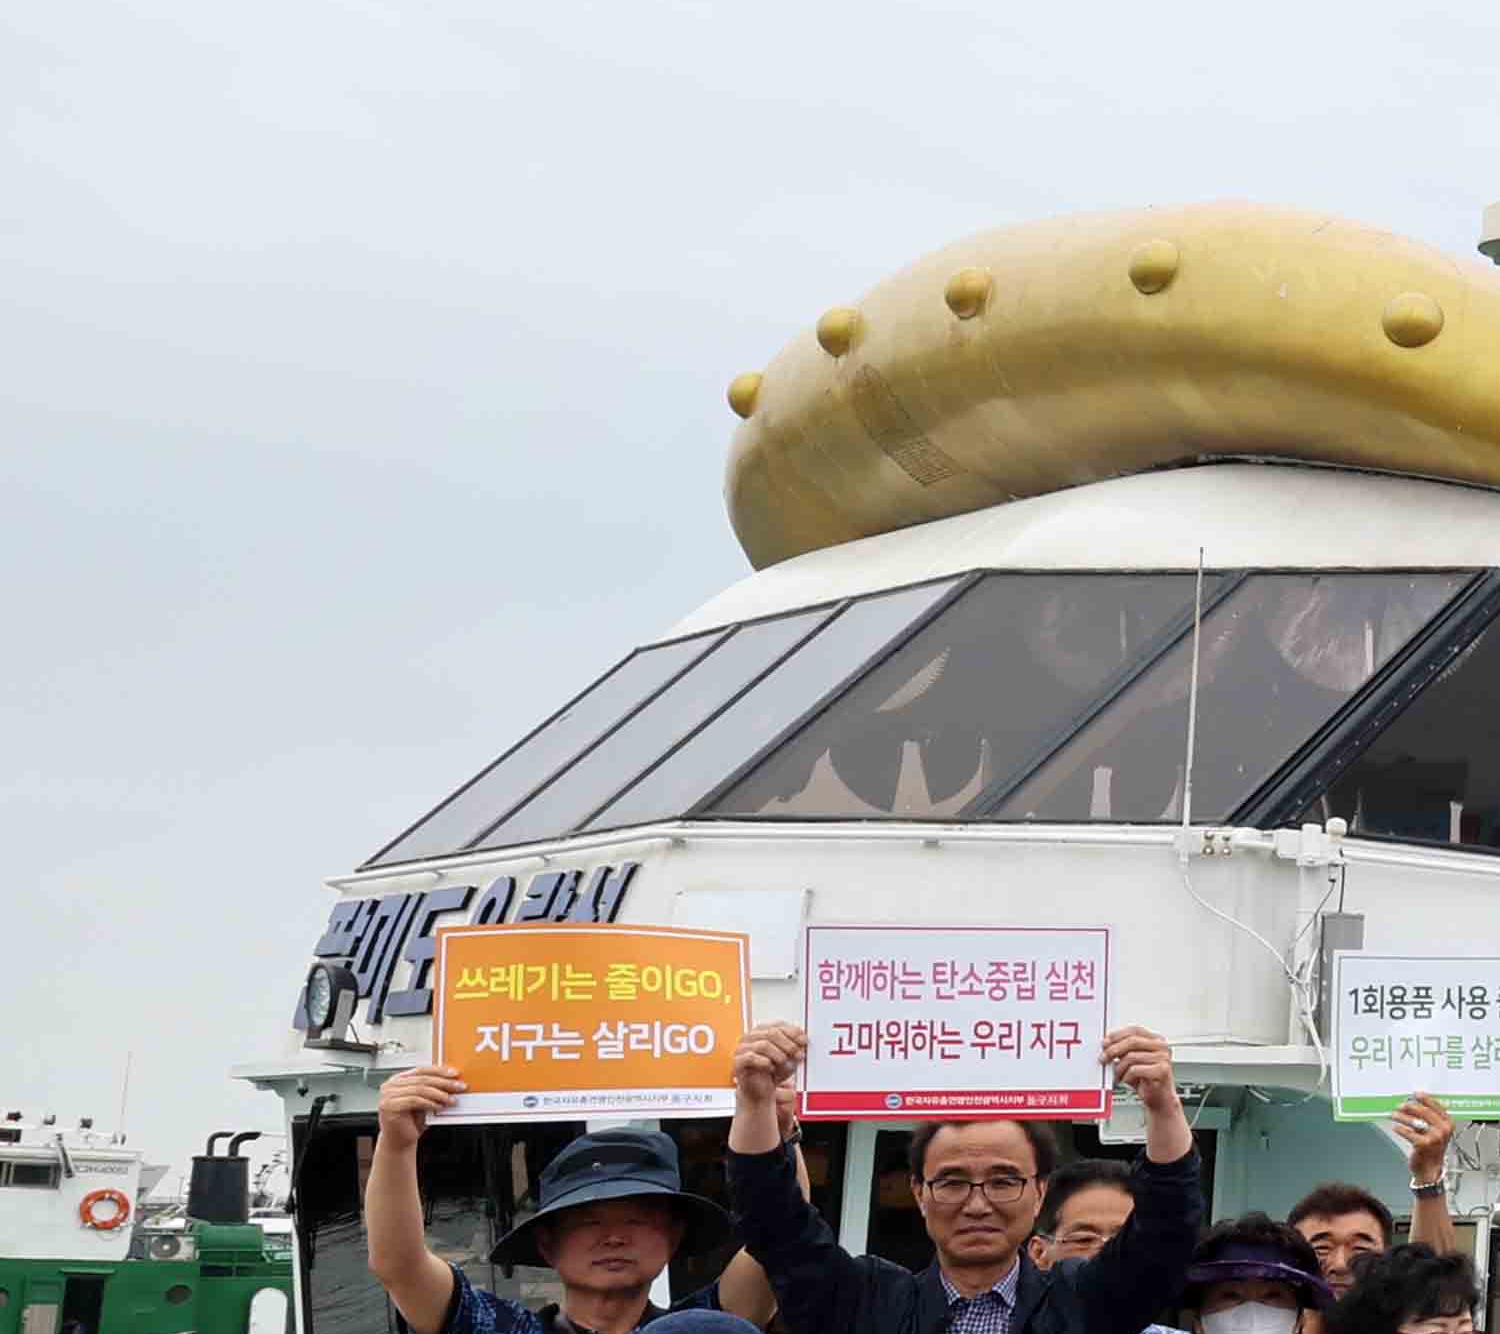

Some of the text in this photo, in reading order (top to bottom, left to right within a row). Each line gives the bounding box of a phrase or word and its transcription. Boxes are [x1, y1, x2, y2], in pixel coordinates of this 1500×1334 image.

[453, 964, 732, 1004] 쓰레기는 줄이GO,
[818, 959, 1094, 1001] 함께하는 탄소중립 실천
[1349, 985, 1435, 1020] 1회용품
[1441, 986, 1489, 1019] 사용
[475, 1022, 715, 1061] 지구는 살리GO
[829, 1020, 1082, 1059] 고마워하는 우리 지구
[1350, 1036, 1392, 1069] 우리
[1401, 1035, 1464, 1069] 지구를
